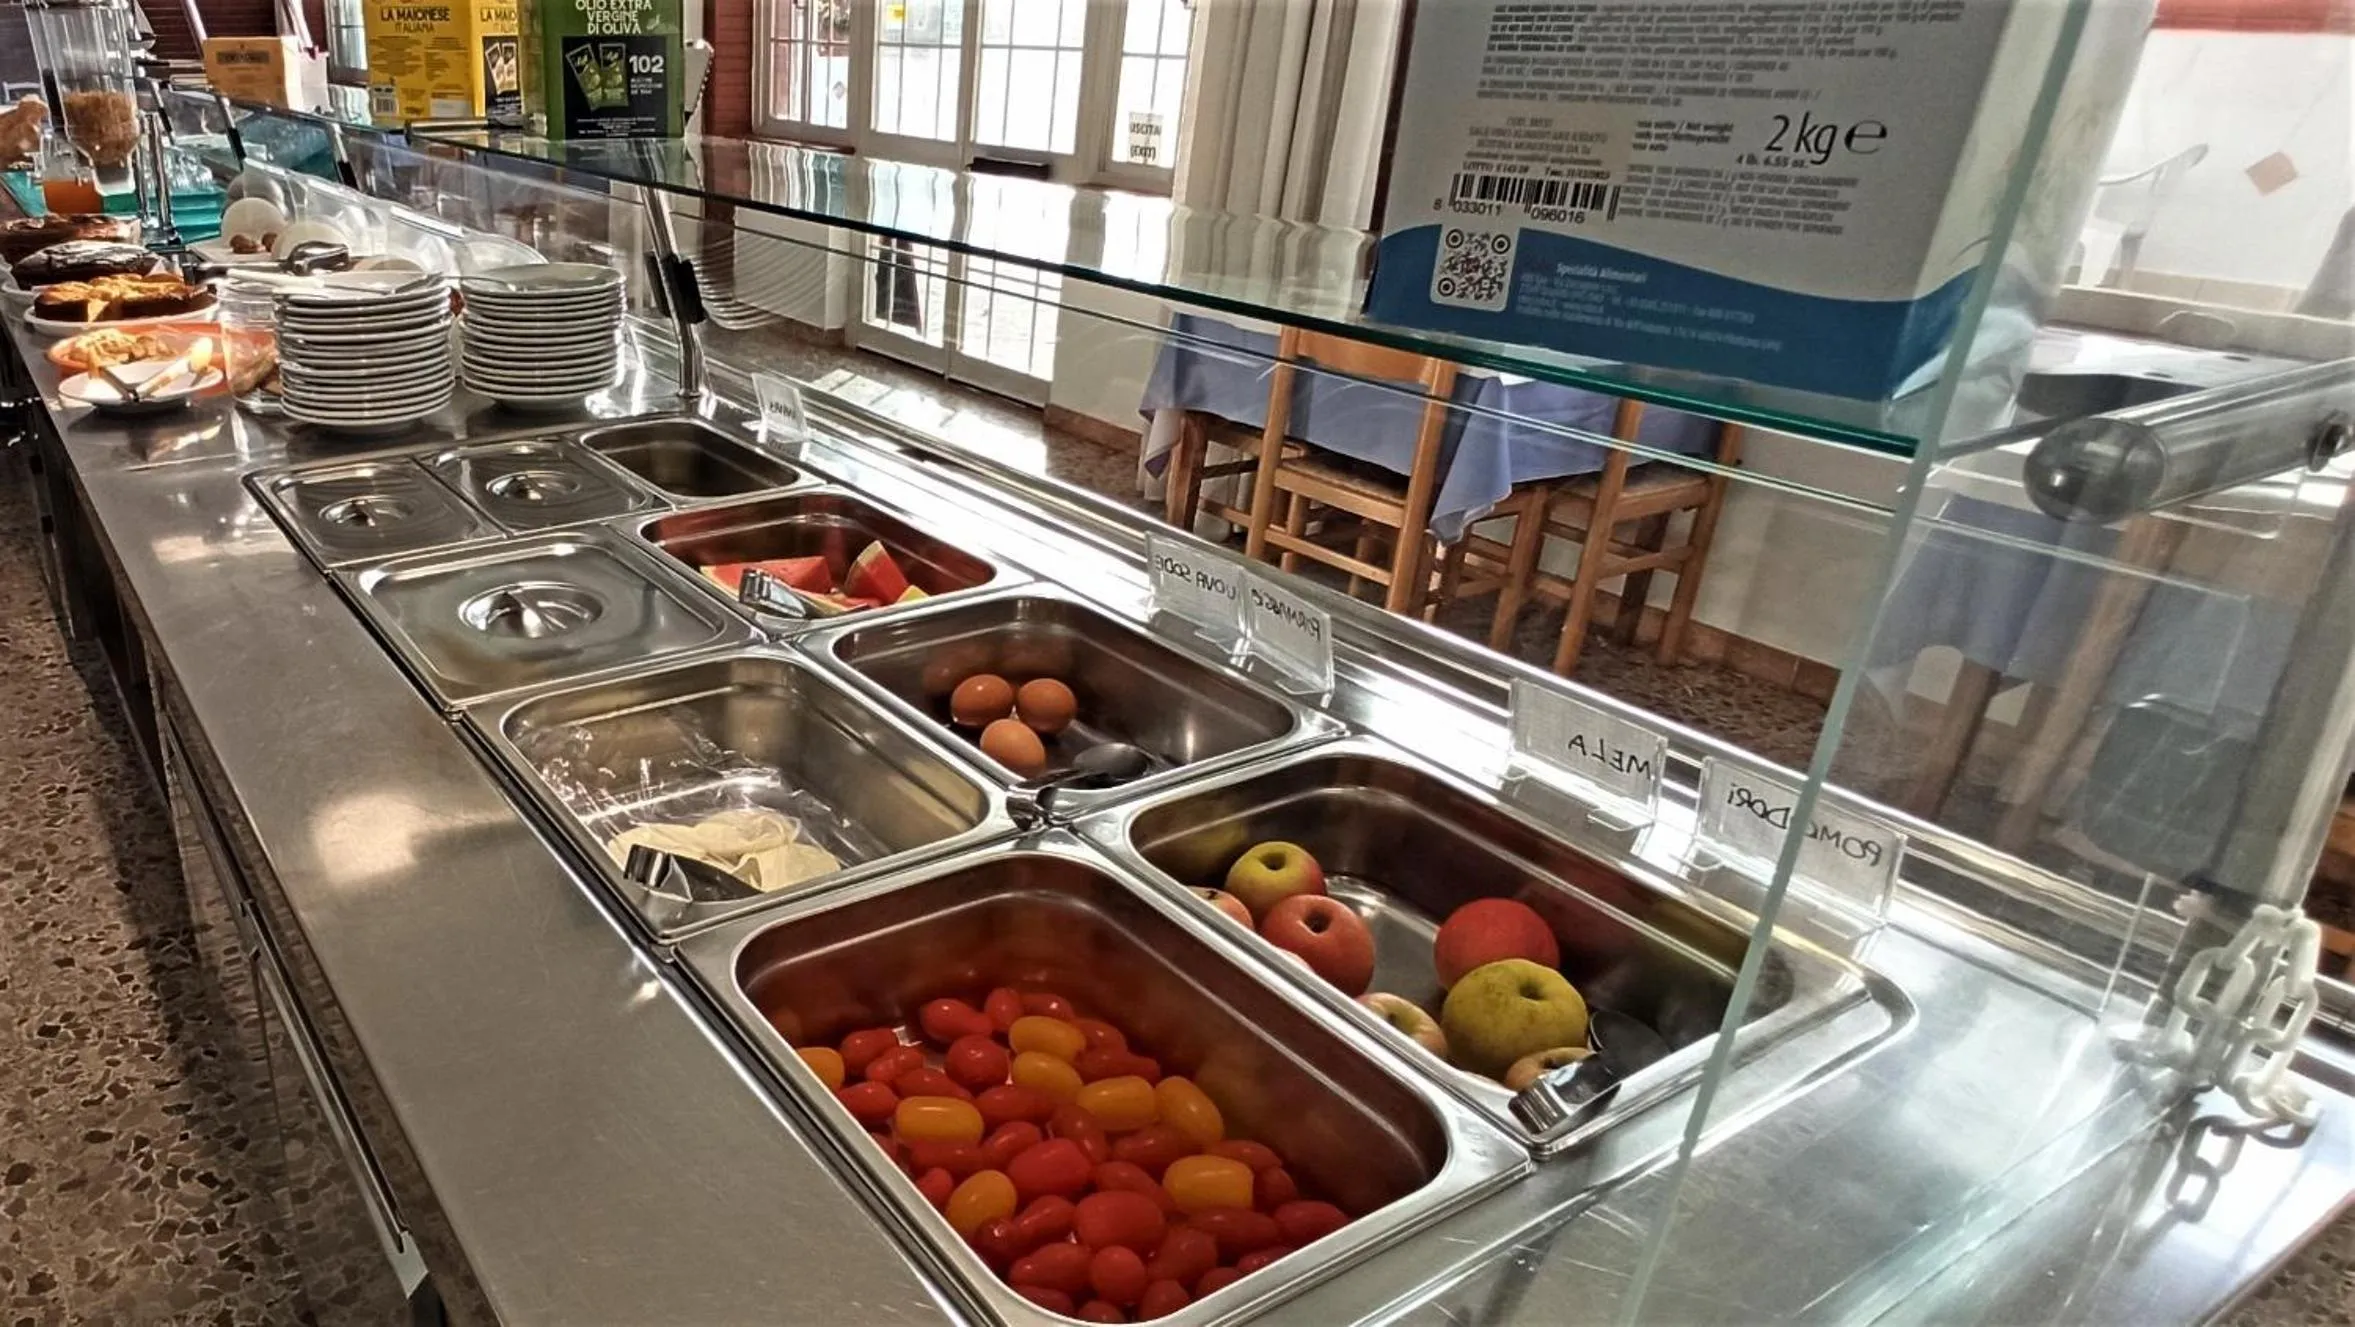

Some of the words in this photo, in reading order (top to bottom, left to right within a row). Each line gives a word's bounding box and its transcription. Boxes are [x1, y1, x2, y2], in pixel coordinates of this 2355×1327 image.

[575, 0, 607, 10] OLIO
[610, 0, 652, 10] EXTRA
[381, 7, 394, 21] LA
[396, 7, 450, 21] MAIONESE
[480, 8, 493, 22] LA
[587, 11, 638, 22] VERGINE
[588, 22, 599, 34] DI
[602, 22, 641, 34] OLIVA
[629, 55, 664, 74] 102
[1764, 114, 1790, 151] 2
[1793, 110, 1838, 165] kg
[1433, 198, 1442, 211] 8
[1452, 200, 1501, 216] 033011
